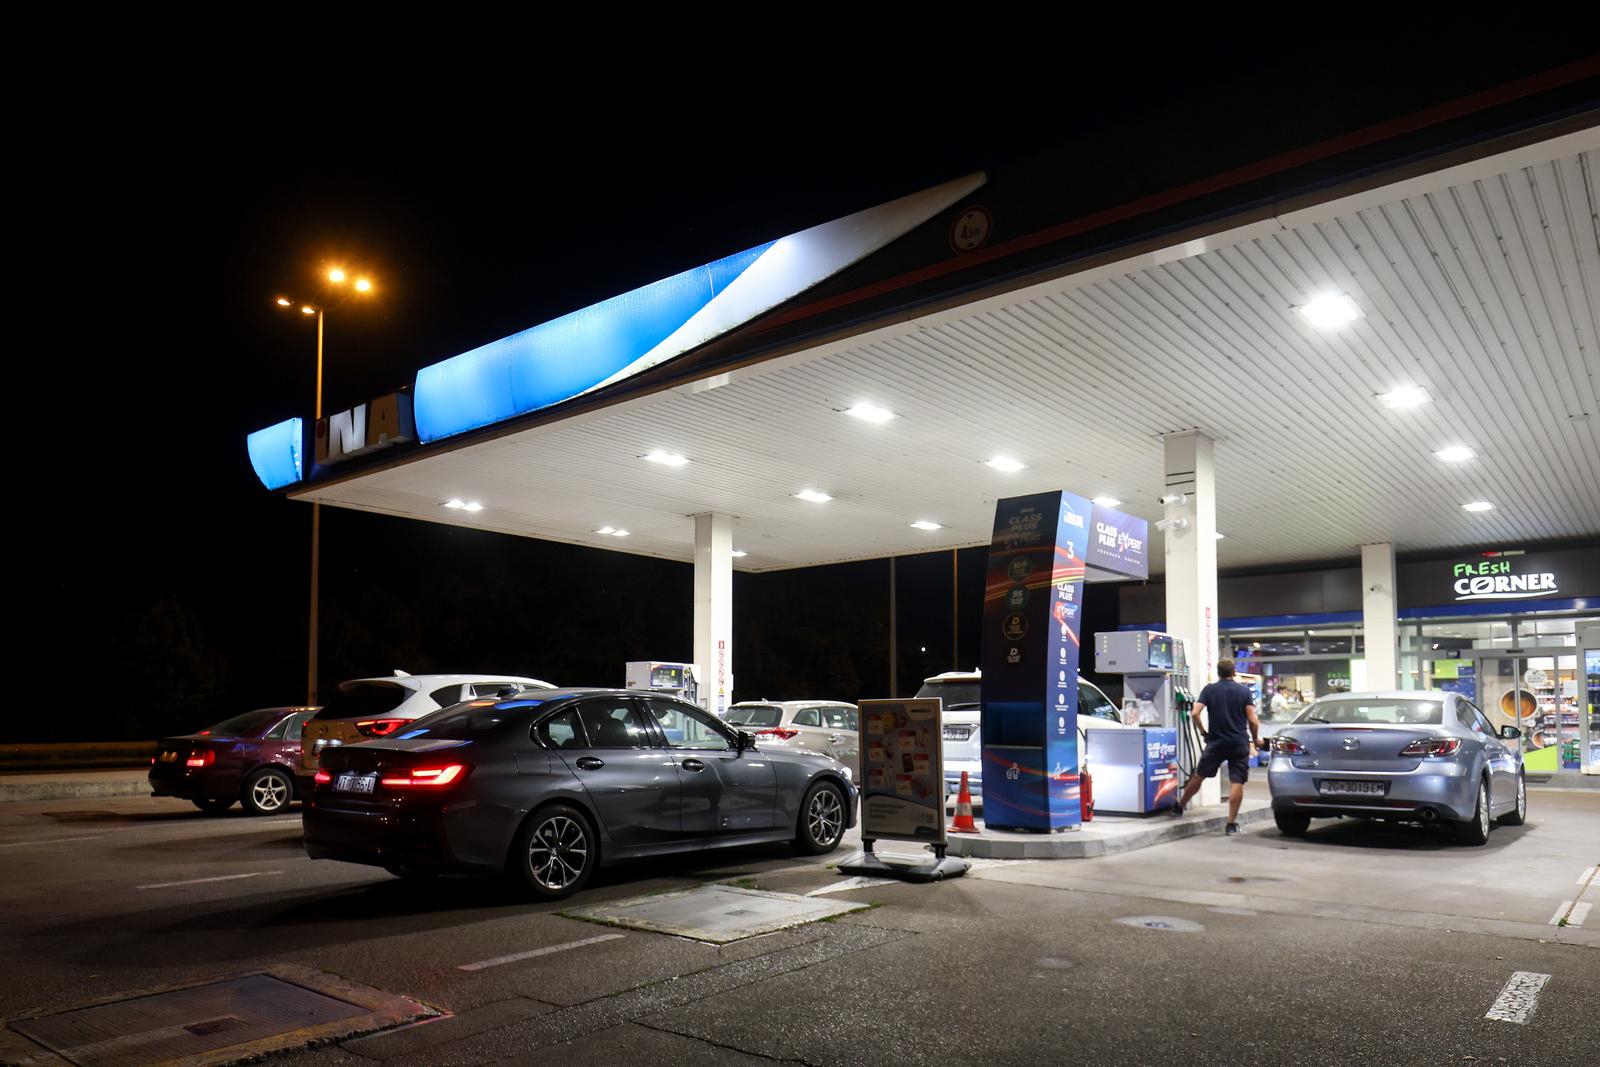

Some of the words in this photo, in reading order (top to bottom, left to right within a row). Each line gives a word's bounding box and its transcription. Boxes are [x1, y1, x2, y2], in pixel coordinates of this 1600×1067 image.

[1096, 522, 1118, 538] CLASS
[1098, 533, 1116, 548] PLUS
[1066, 540, 1074, 559] 3
[1453, 561, 1511, 577] FRESH
[1454, 572, 1557, 595] CORNER
